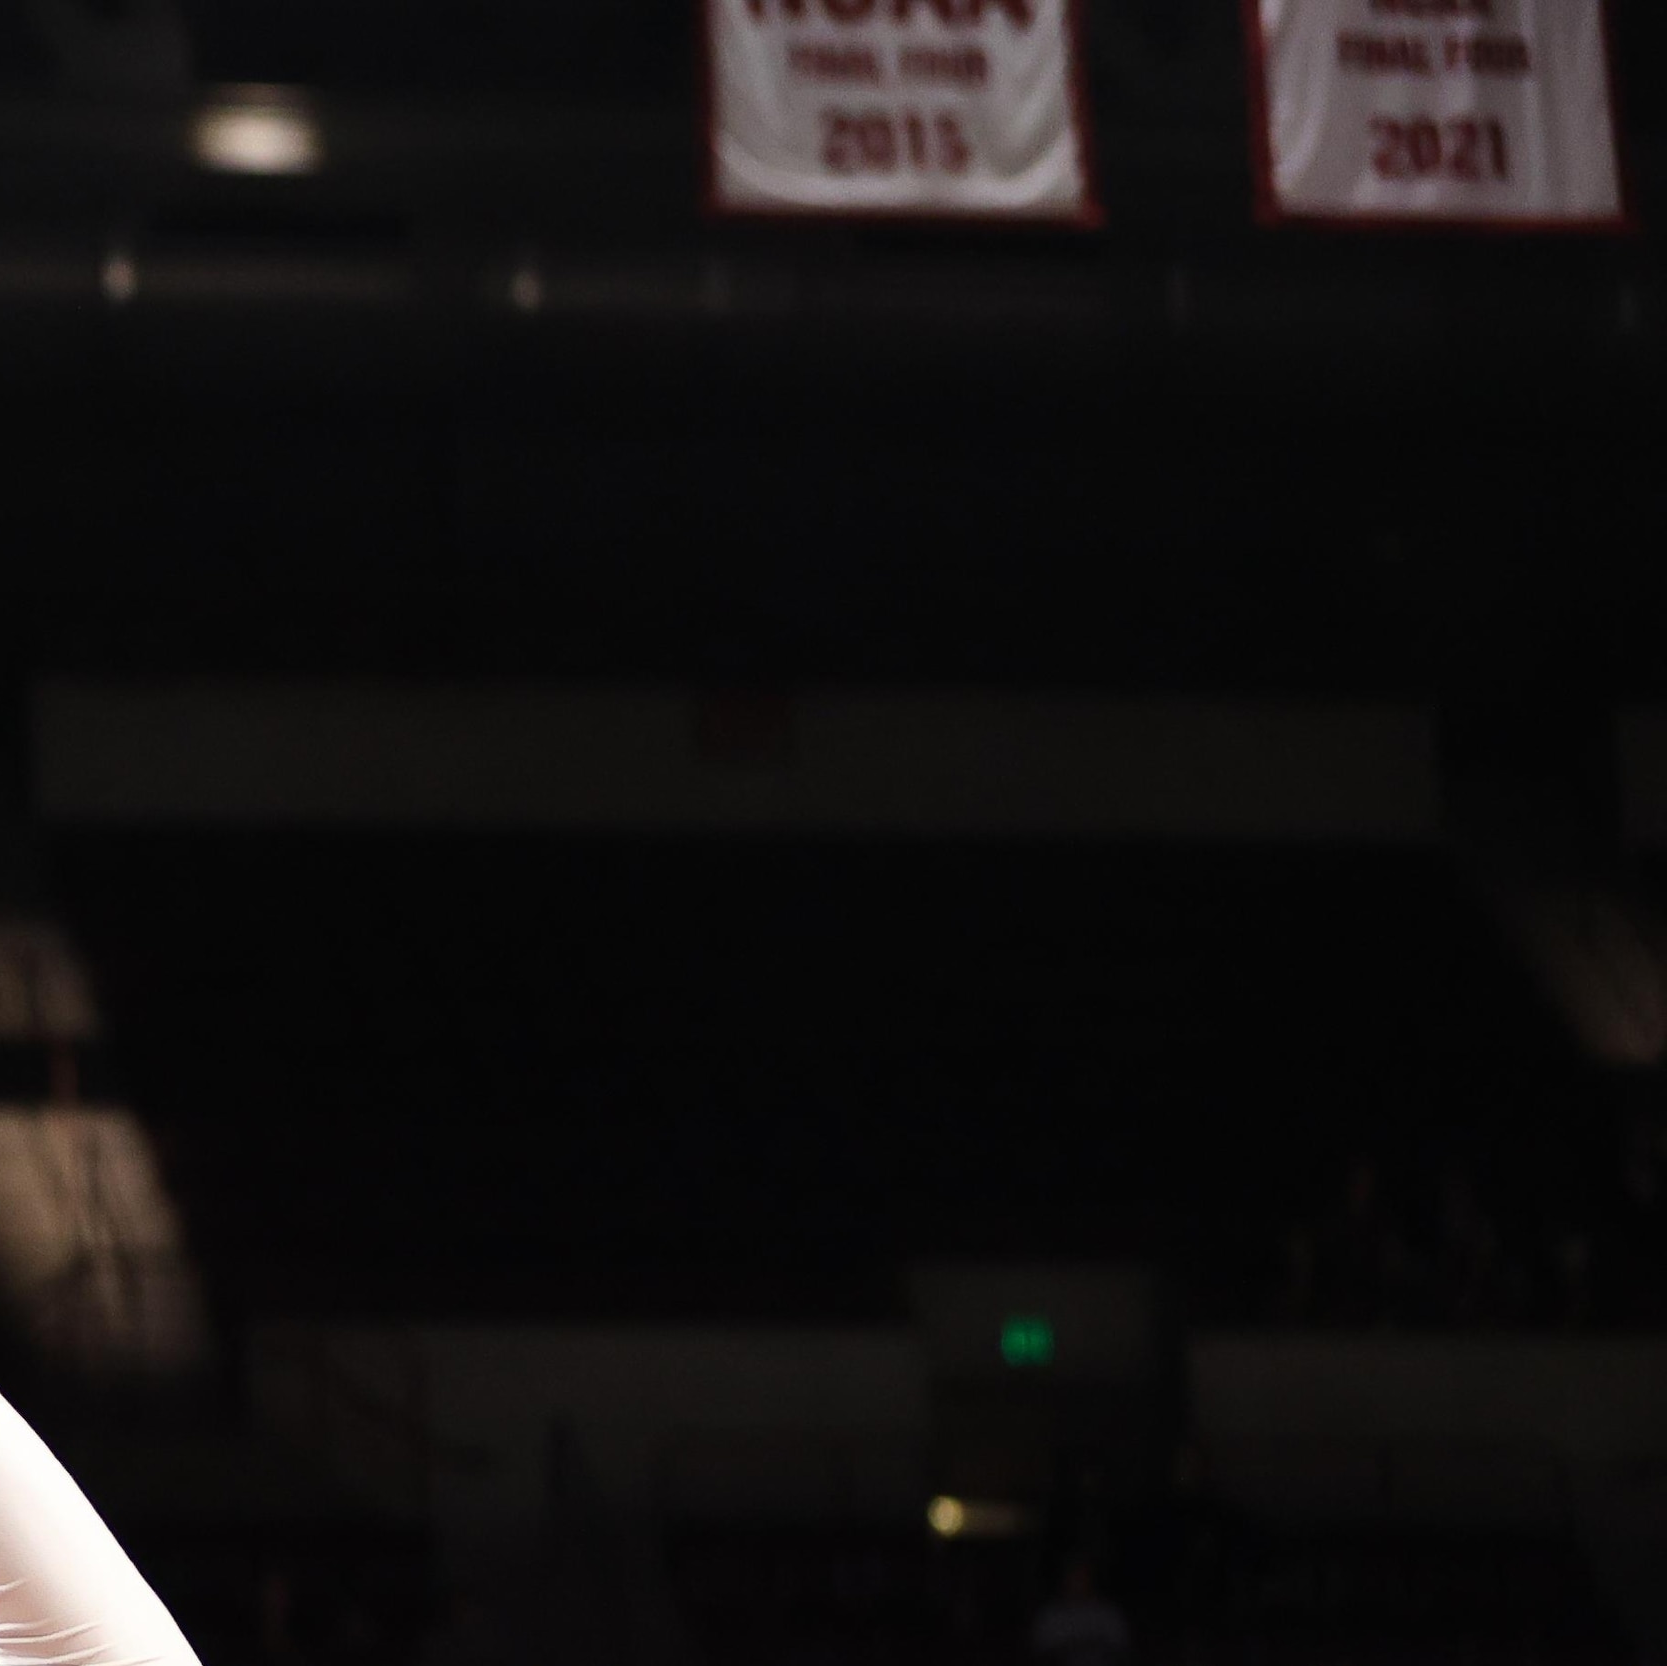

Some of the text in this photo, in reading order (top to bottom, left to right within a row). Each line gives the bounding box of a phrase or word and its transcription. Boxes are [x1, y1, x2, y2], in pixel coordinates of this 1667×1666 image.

[1337, 31, 1436, 78] FINAL
[819, 105, 973, 178] 2015
[1368, 112, 1511, 185] 2021
